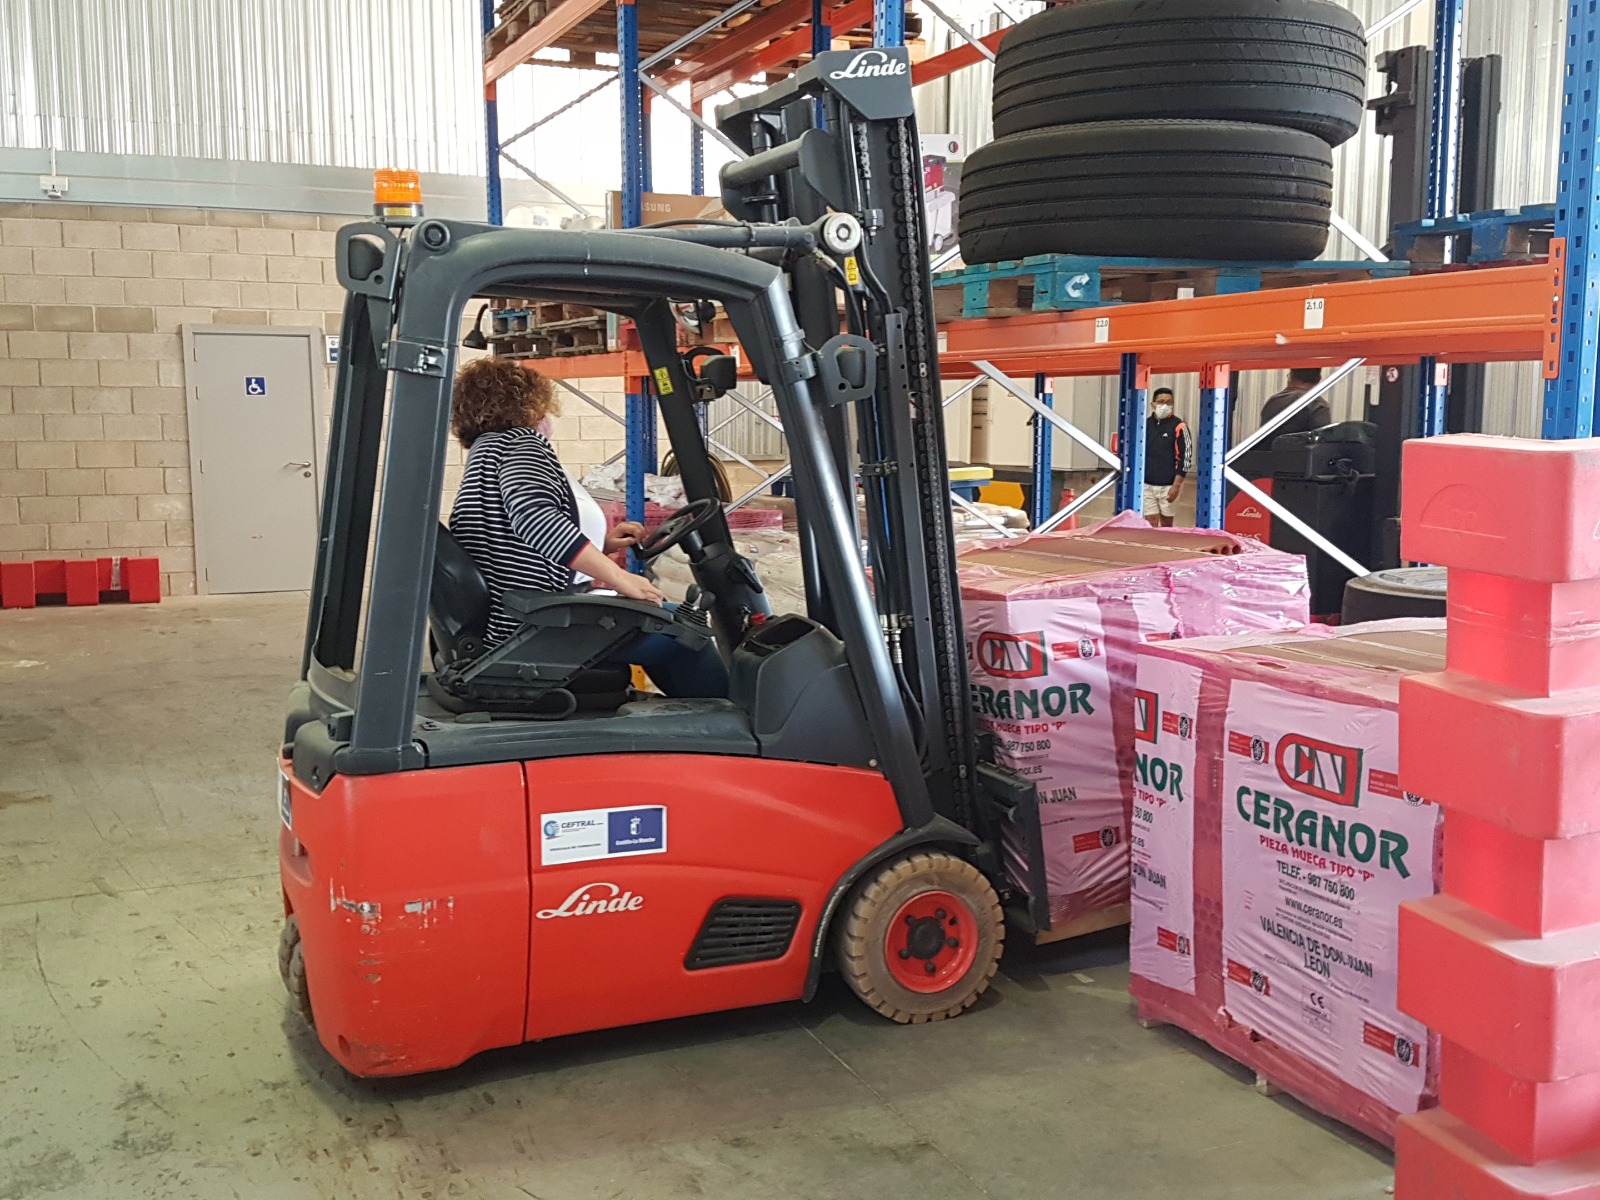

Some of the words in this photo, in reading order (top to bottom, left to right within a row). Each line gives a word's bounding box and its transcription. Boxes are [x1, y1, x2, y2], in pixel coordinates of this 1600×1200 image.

[829, 50, 906, 79] Linde
[641, 202, 671, 212] SUNG
[1236, 506, 1262, 518] Linde
[1024, 723, 1049, 735] TIPO
[1020, 741, 1034, 752] 750
[1037, 739, 1051, 750] 800
[1050, 787, 1077, 803] JUAN
[1138, 789, 1154, 805] TIPO
[1236, 785, 1411, 879] CERANOR
[1259, 834, 1289, 855] PIEZA
[1291, 847, 1327, 869] HUECA
[1330, 860, 1355, 878] TIPO
[1358, 869, 1375, 882] "P"
[1148, 868, 1167, 889] JUAN
[1307, 873, 1322, 887] 987
[1323, 878, 1338, 894] 750
[1339, 884, 1355, 900] 800
[536, 882, 644, 919] Linde
[1284, 895, 1344, 929] www.ceranor.es
[1260, 915, 1306, 950] VALENCIA
[1306, 937, 1321, 956] DE
[1304, 952, 1331, 979] LEON
